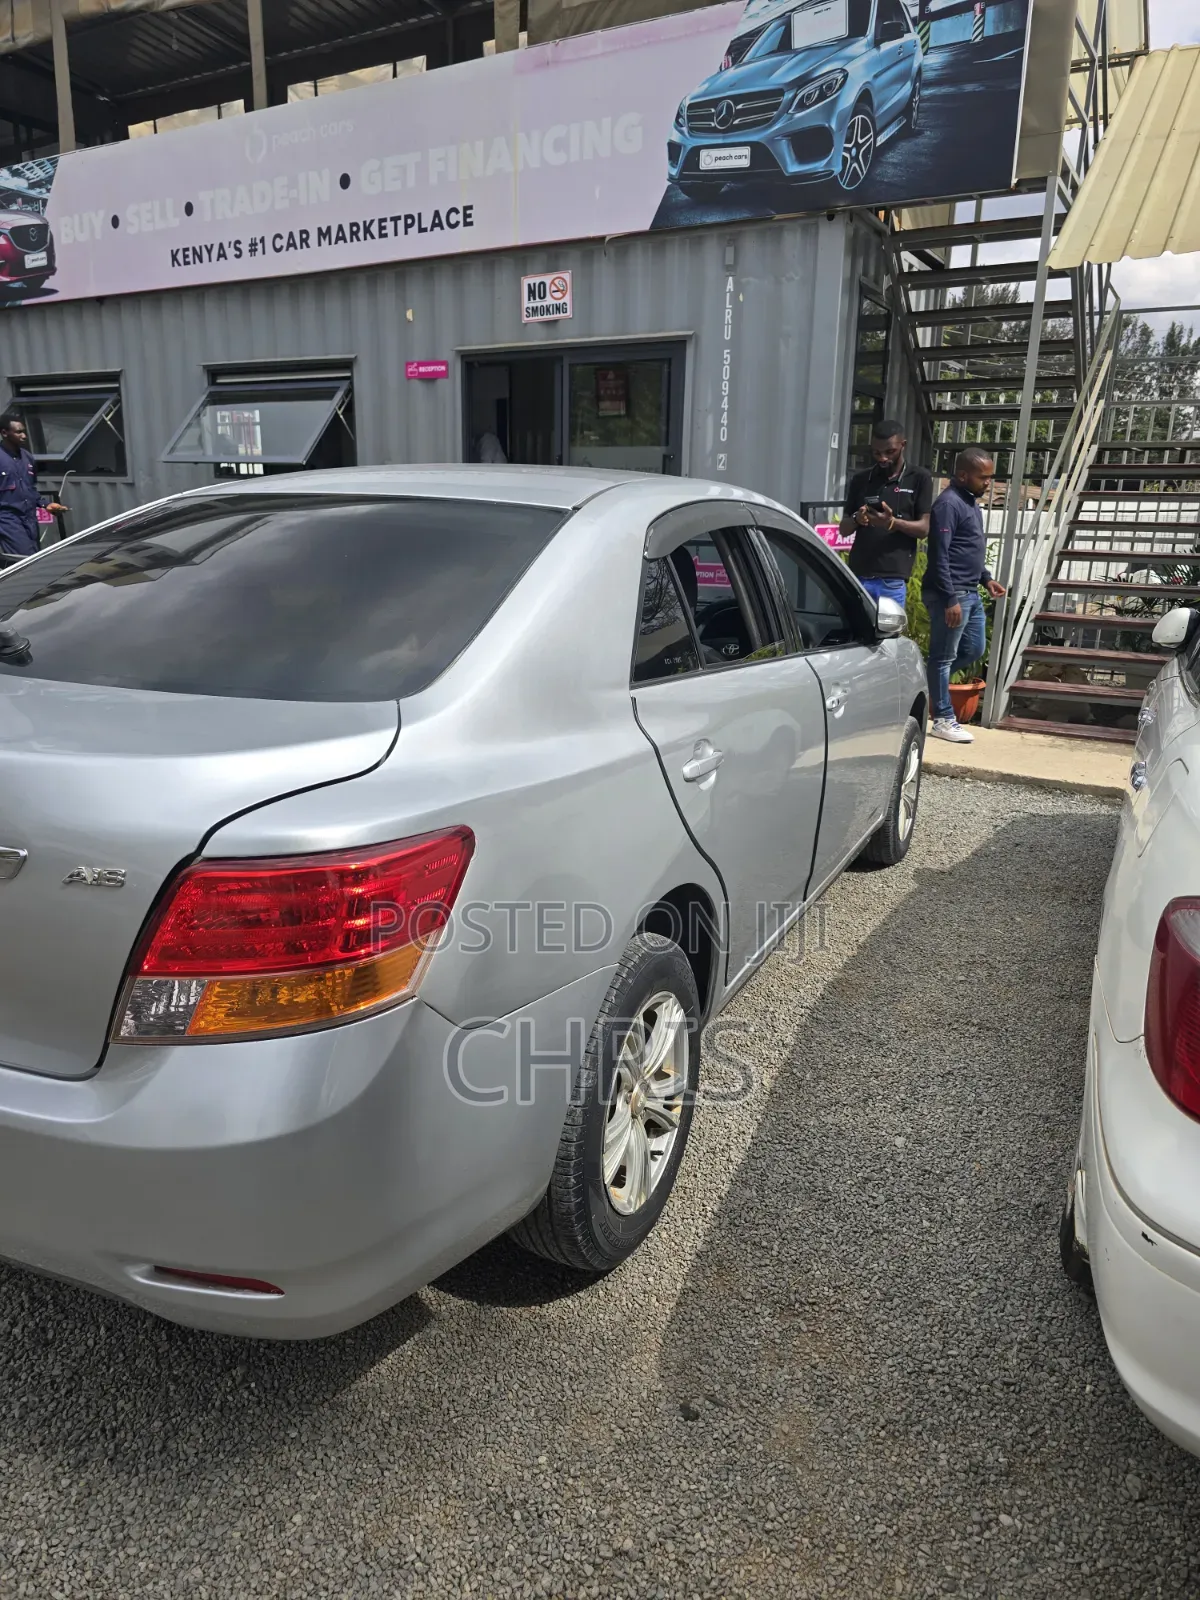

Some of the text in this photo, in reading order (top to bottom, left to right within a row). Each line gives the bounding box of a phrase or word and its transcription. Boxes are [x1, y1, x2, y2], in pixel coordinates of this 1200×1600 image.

[319, 119, 354, 138] cars
[60, 111, 643, 245] BUY SELL TRADE-IN GET FINANCING
[170, 204, 475, 268] KENYA'S #1 CAR MARKETPLACE
[525, 302, 568, 318] SMOKING
[527, 281, 547, 302] NO
[723, 276, 734, 340] ALRU
[720, 349, 731, 442] 509440
